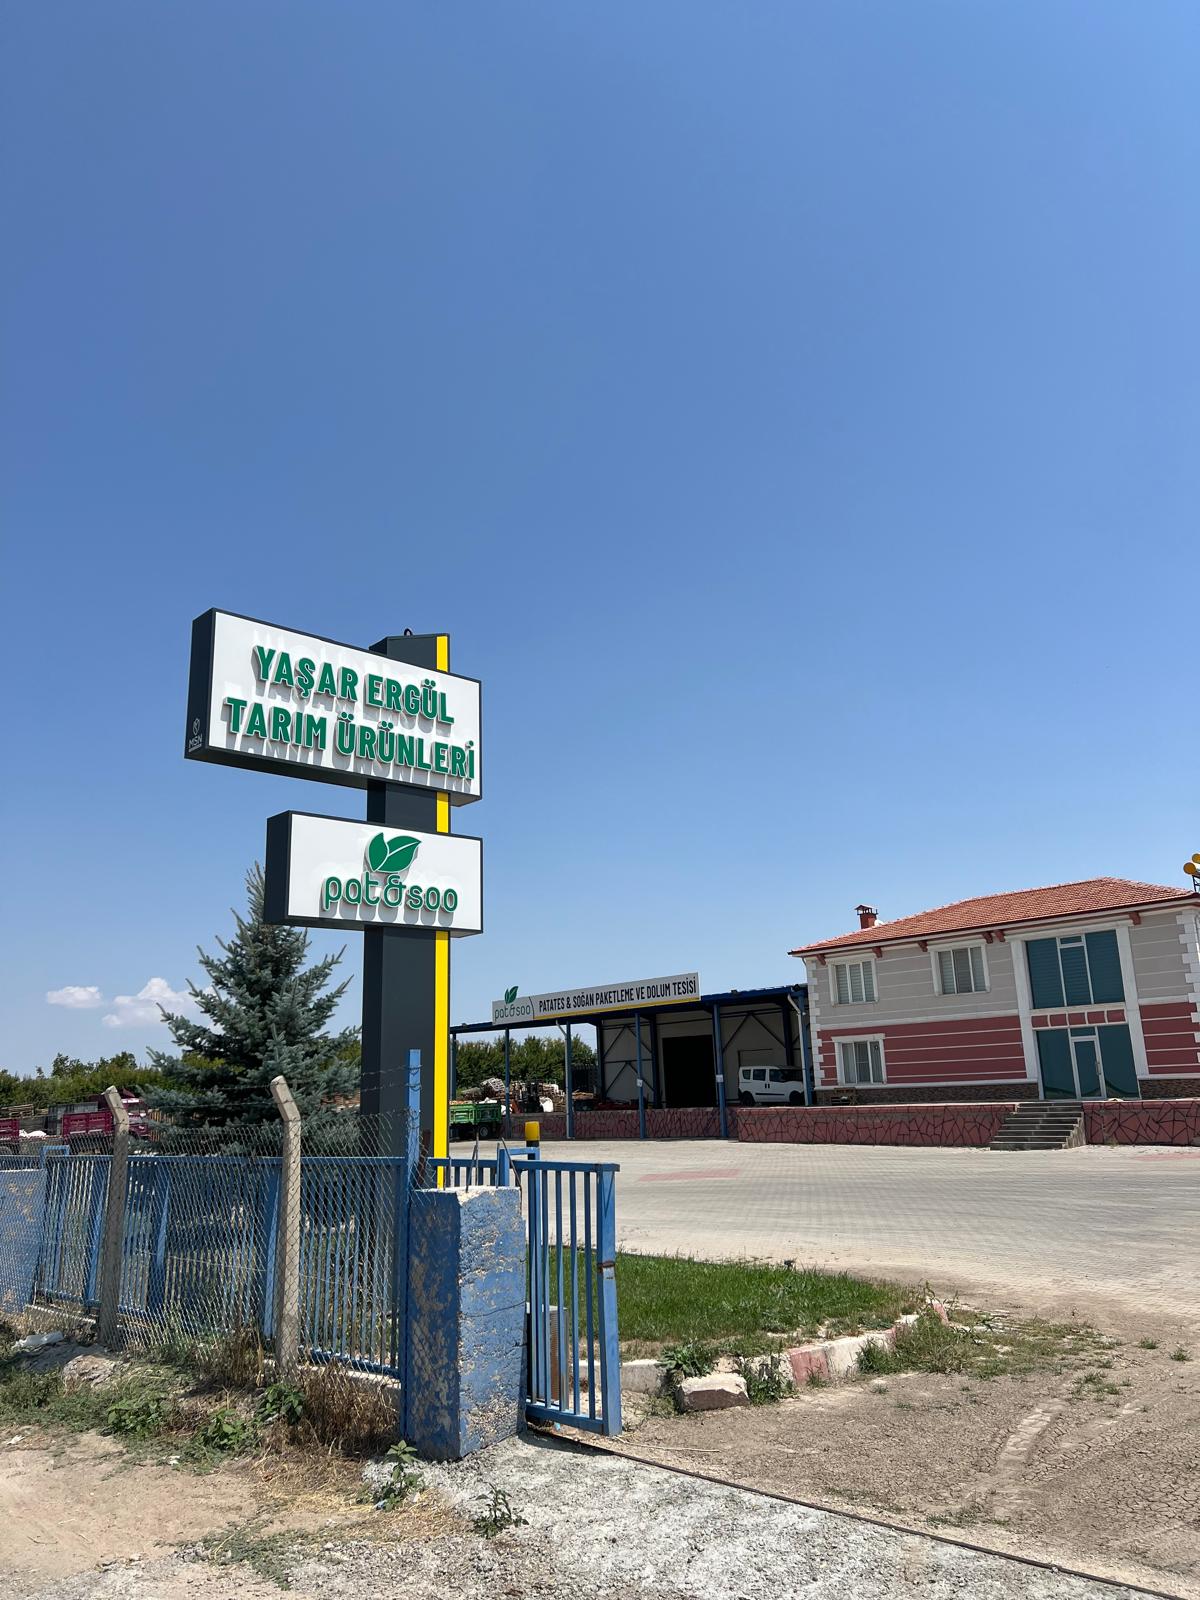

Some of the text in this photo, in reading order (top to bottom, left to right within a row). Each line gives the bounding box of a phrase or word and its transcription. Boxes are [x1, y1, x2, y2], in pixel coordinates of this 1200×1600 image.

[255, 646, 455, 724] YAŞAR ERGÜL
[226, 697, 475, 779] TARIM ÜRÜNLERİ
[322, 871, 459, 912] pat&soo
[539, 976, 697, 1012] PATATES & SOĞAN PAKETLEME VE DOLUM TESİSİ
